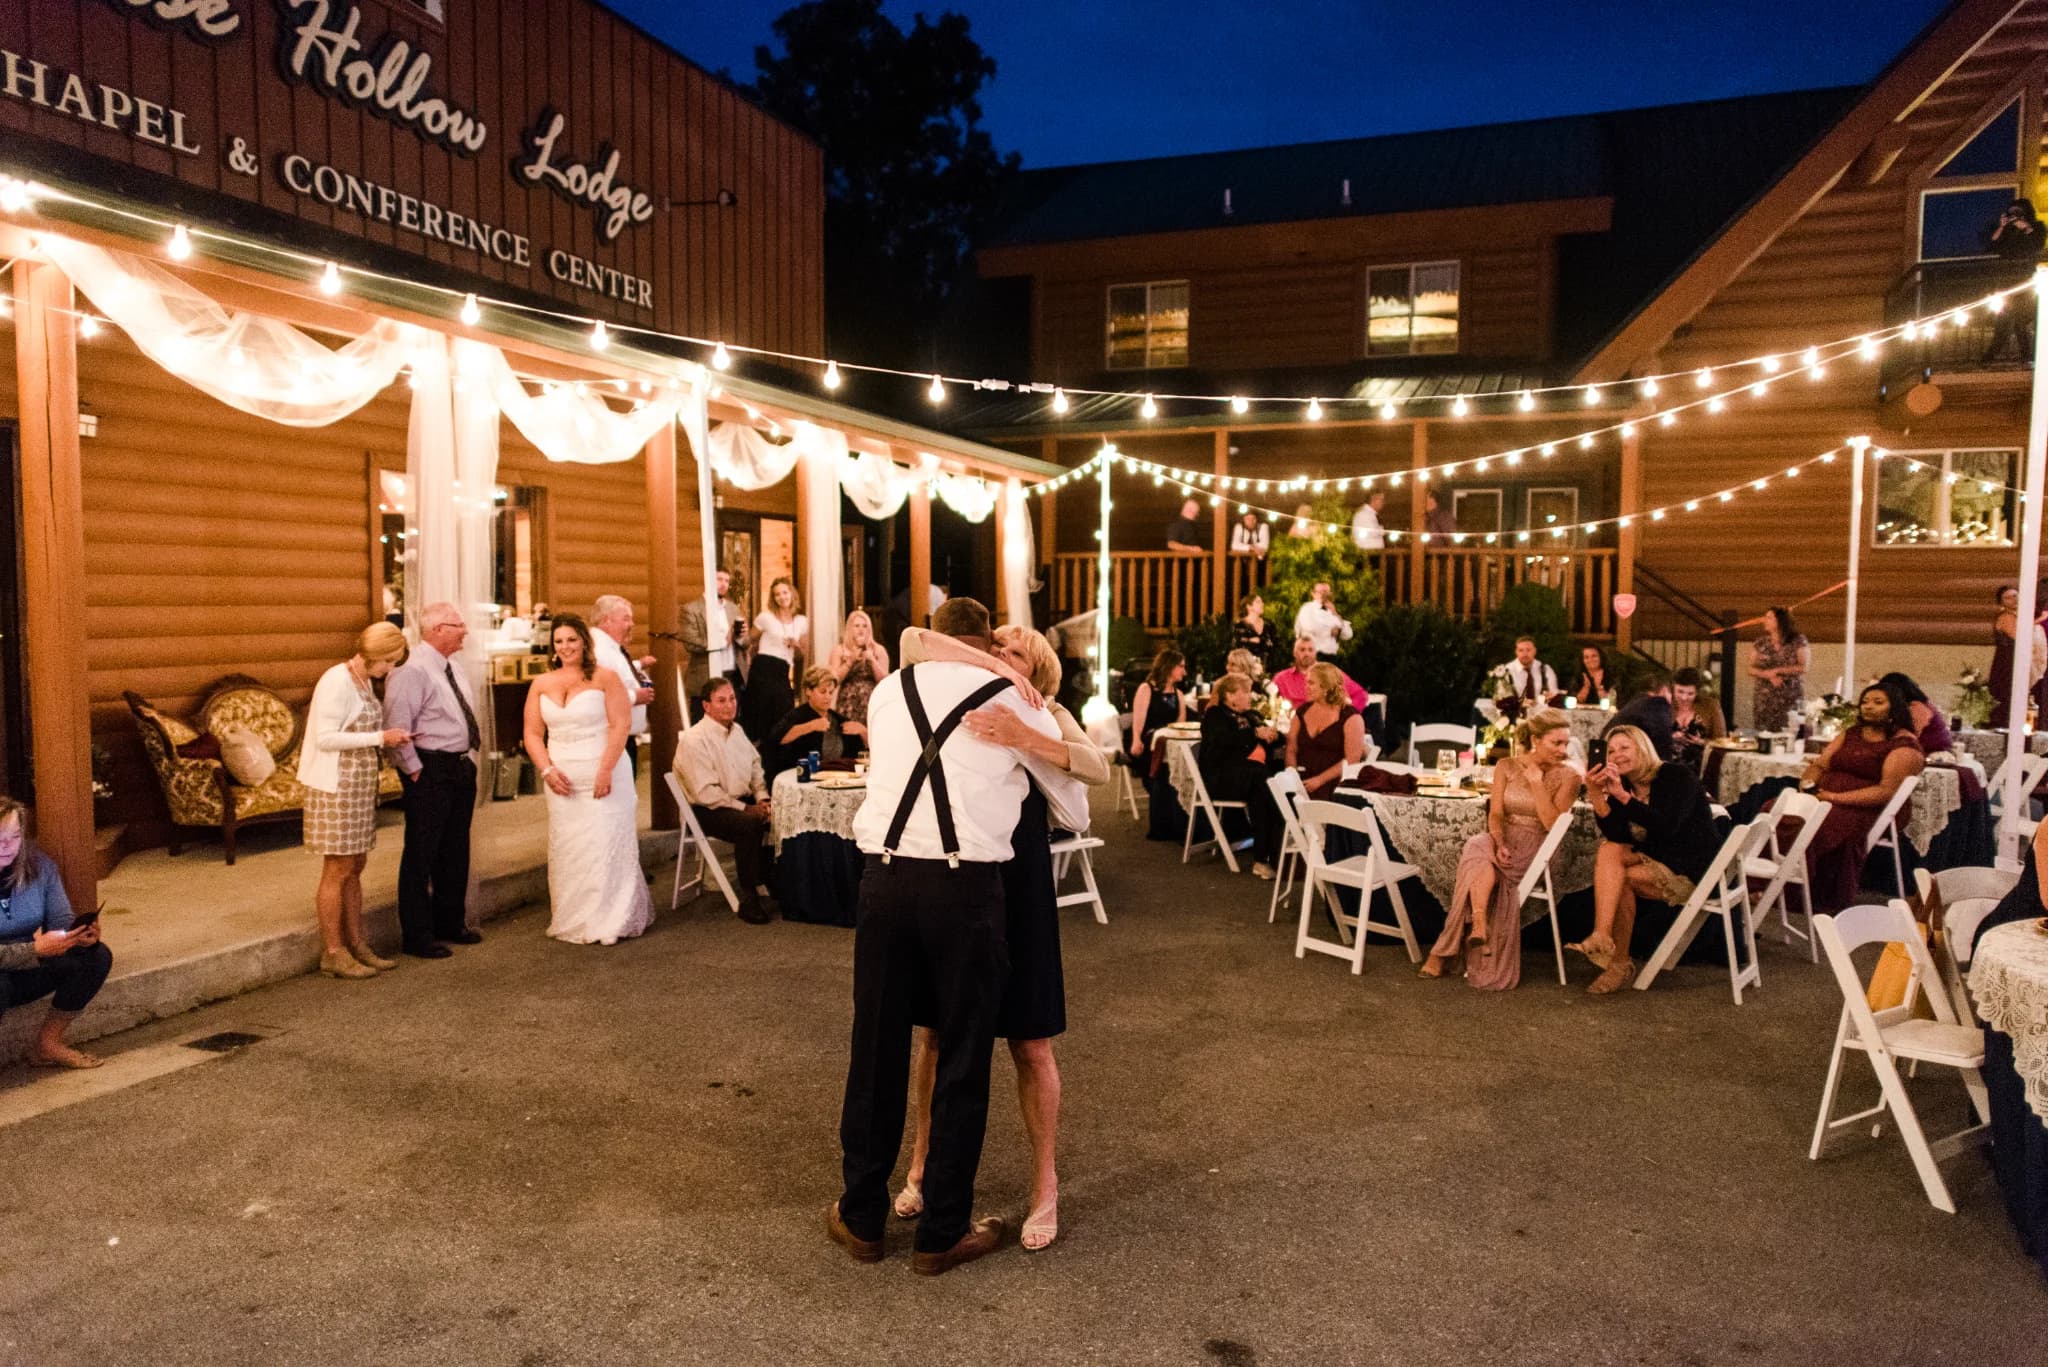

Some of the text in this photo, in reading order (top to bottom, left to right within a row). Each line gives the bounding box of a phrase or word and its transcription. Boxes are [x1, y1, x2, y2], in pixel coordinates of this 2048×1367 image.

[228, 136, 259, 176] &
[284, 155, 531, 267] CONFERENCE
[550, 250, 653, 309] CENTER
[289, 0, 653, 239] Hollow Lodge
